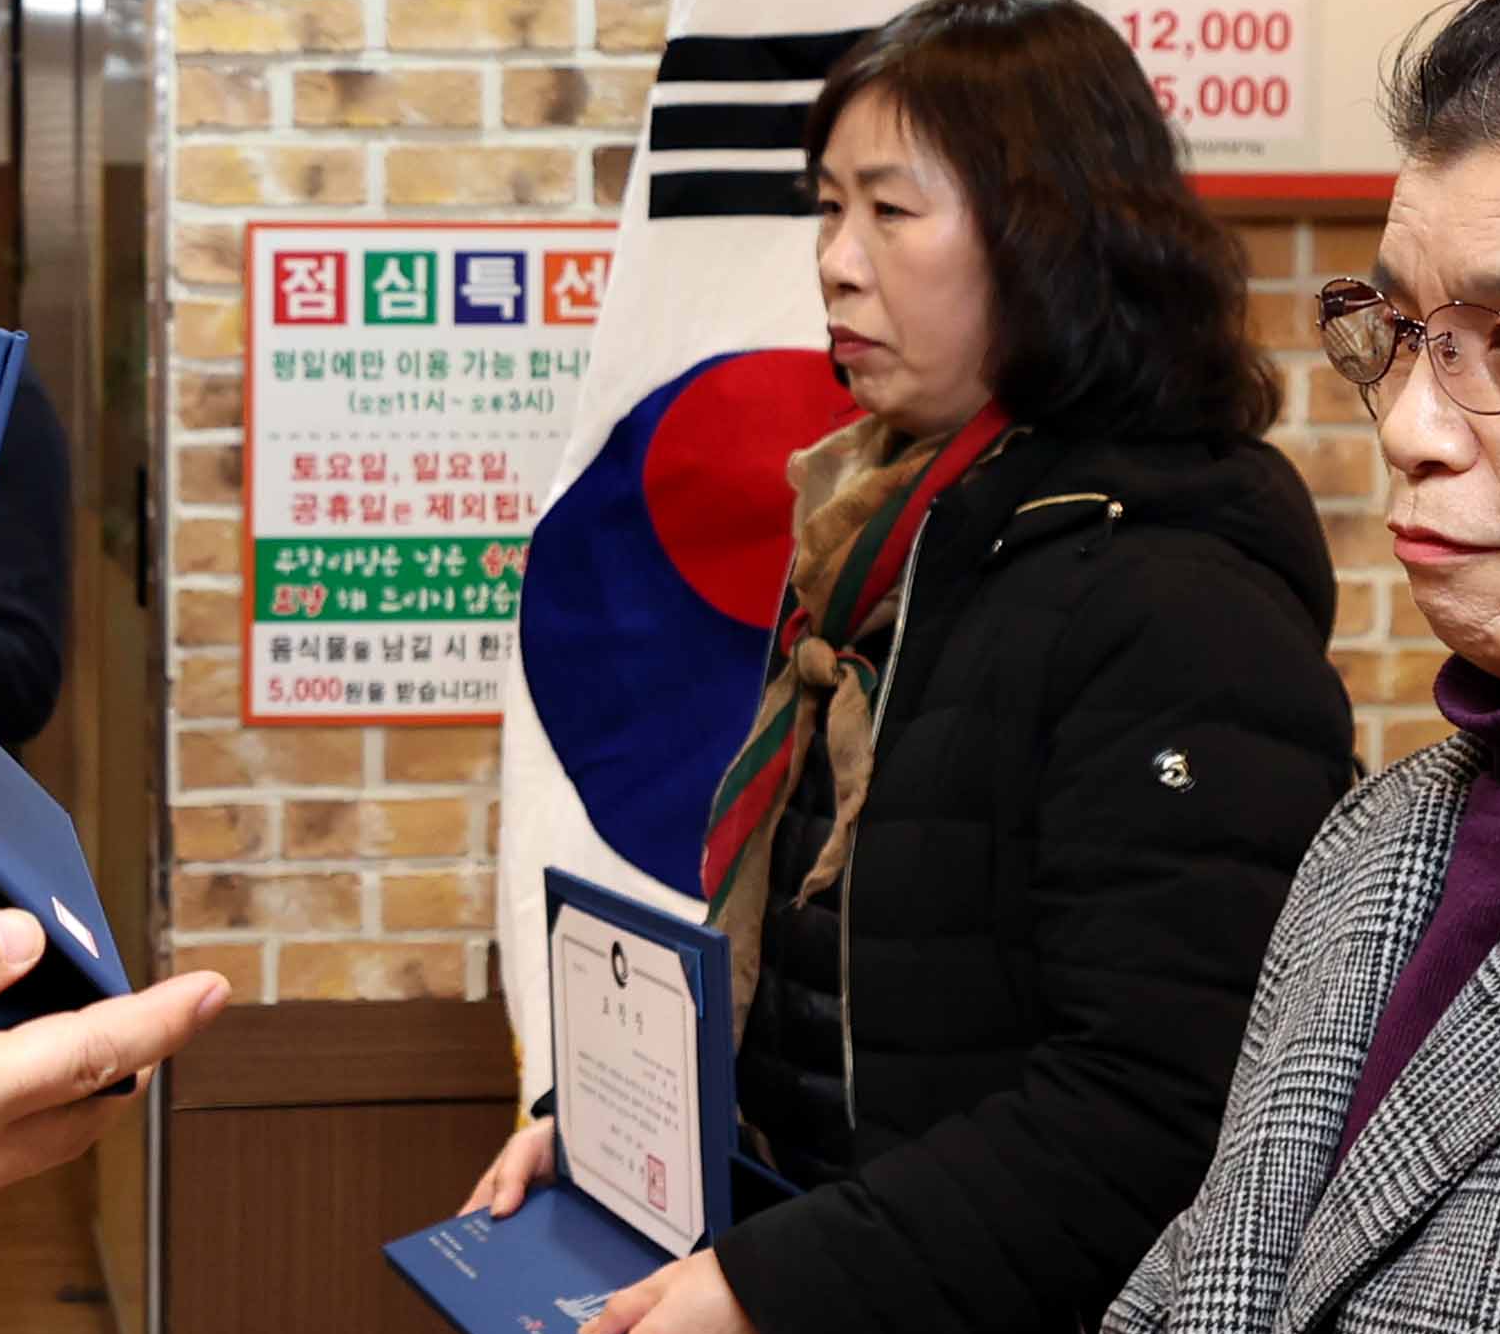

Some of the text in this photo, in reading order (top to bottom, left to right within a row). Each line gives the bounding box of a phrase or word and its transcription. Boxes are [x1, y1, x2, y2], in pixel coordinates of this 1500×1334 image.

[1121, 11, 1292, 58] 12,000
[273, 349, 591, 381] 평일에만 이용 가능 합니
[291, 450, 519, 484] 토요일, 일요일,
[291, 492, 412, 526] 공휴일은
[270, 633, 371, 663] 음식물을
[382, 633, 432, 663] 남길
[445, 634, 467, 660] 시
